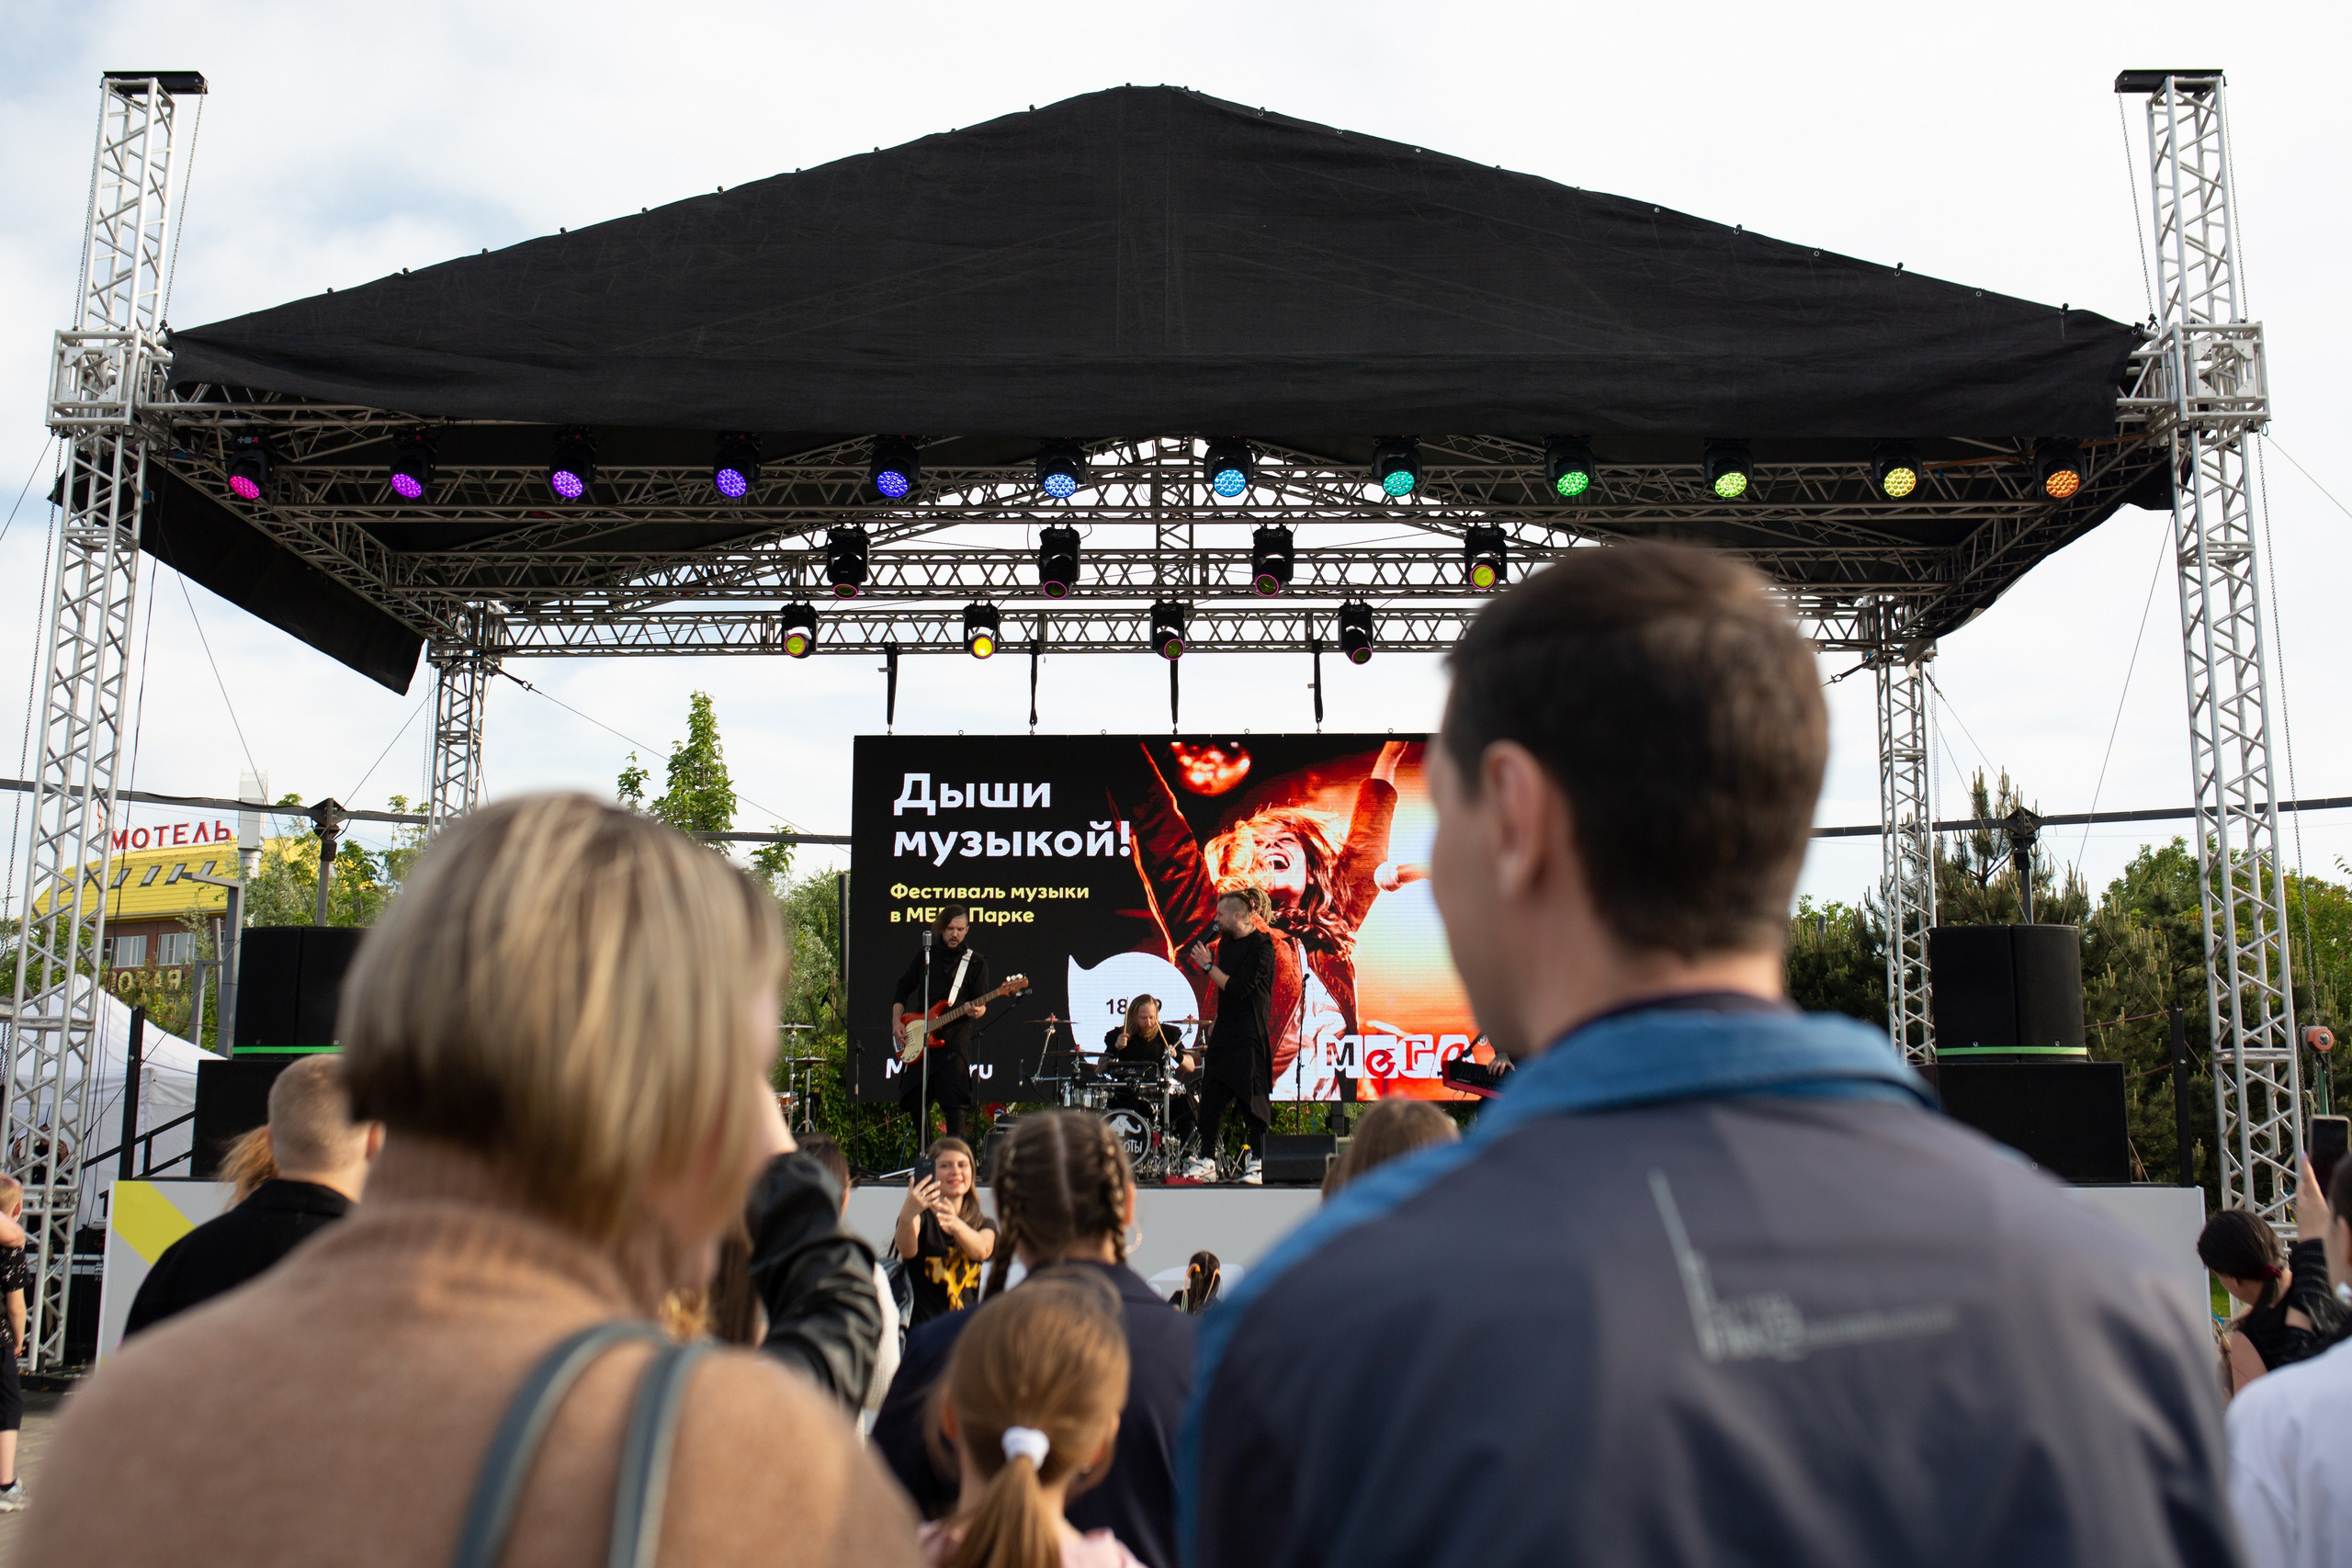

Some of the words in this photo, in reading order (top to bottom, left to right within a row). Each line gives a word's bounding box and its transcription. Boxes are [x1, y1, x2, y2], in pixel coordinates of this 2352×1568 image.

[893, 773, 1051, 816] Дыши
[111, 820, 232, 851] МОТЕЛЬ
[893, 820, 1131, 867] музыкой!
[889, 882, 1006, 899] Фестиваль
[1011, 886, 1090, 903] музыки
[890, 910, 901, 923] в
[968, 907, 1035, 927] Парке
